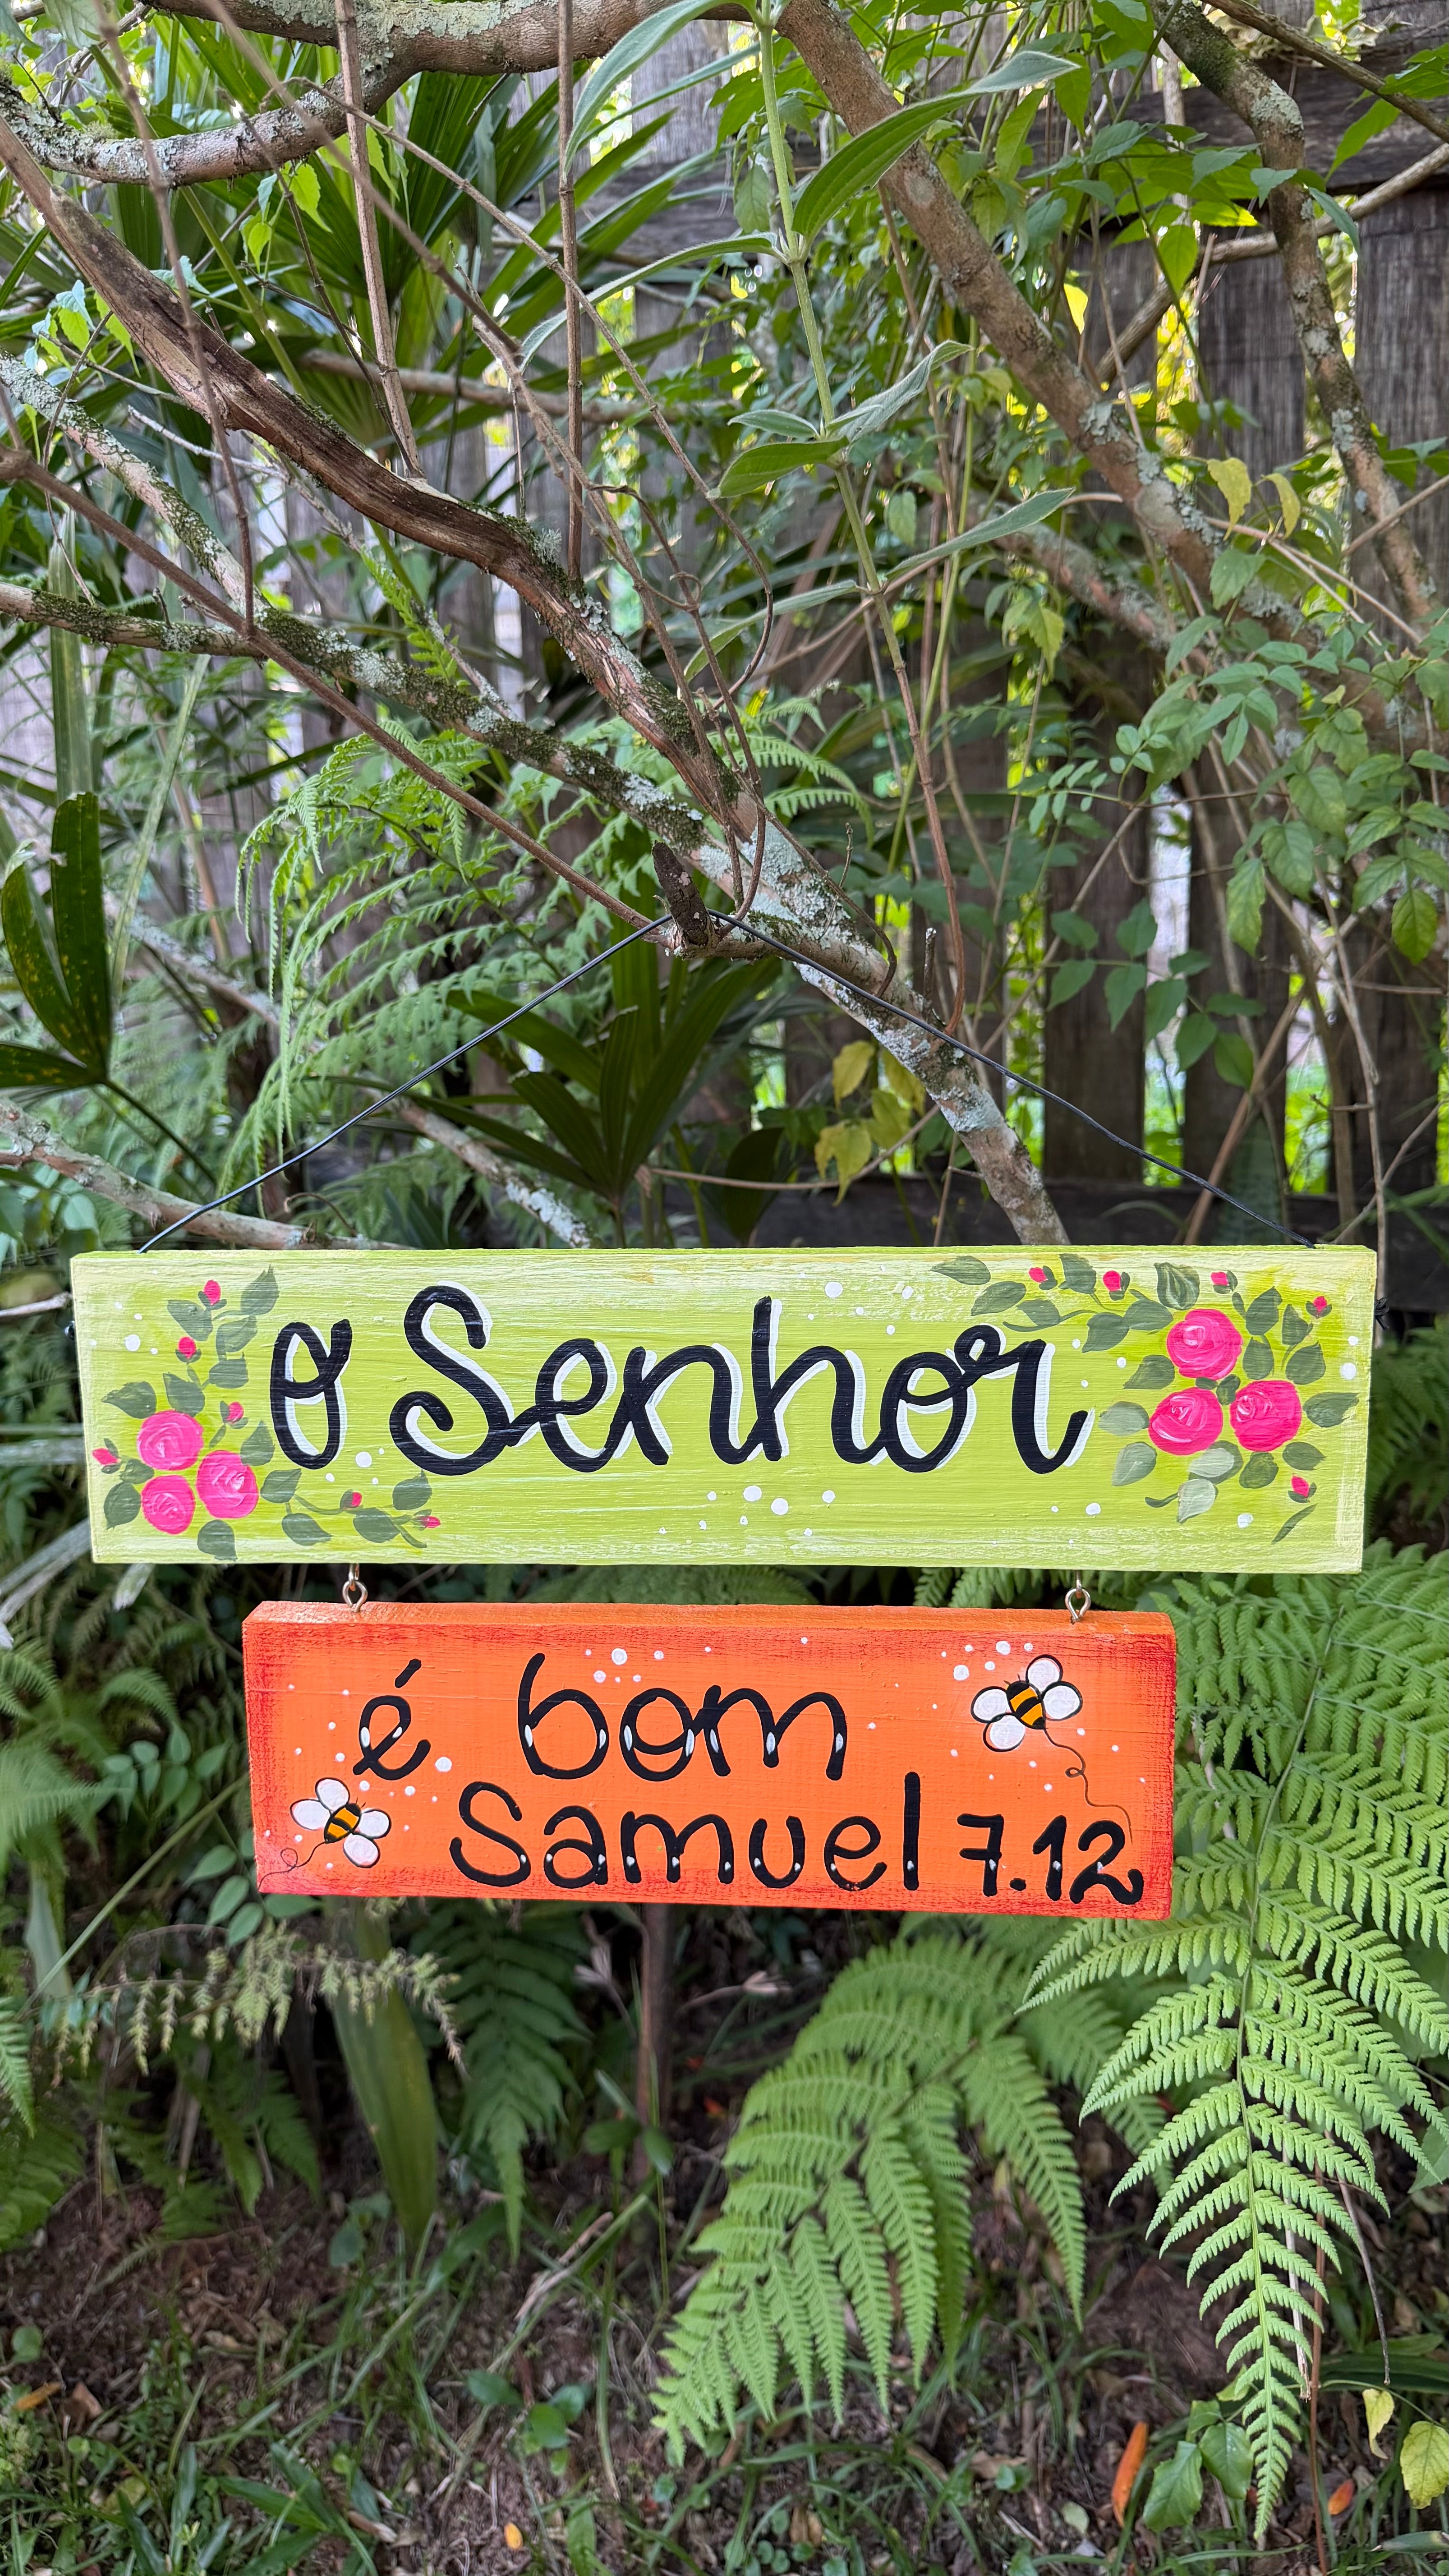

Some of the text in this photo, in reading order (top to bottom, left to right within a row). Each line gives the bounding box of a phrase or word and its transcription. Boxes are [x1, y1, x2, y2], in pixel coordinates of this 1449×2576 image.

[389, 1284, 1091, 1476] Senhor
[353, 1653, 847, 1782] é bom
[449, 1771, 1144, 1905] Samuel 7.12
